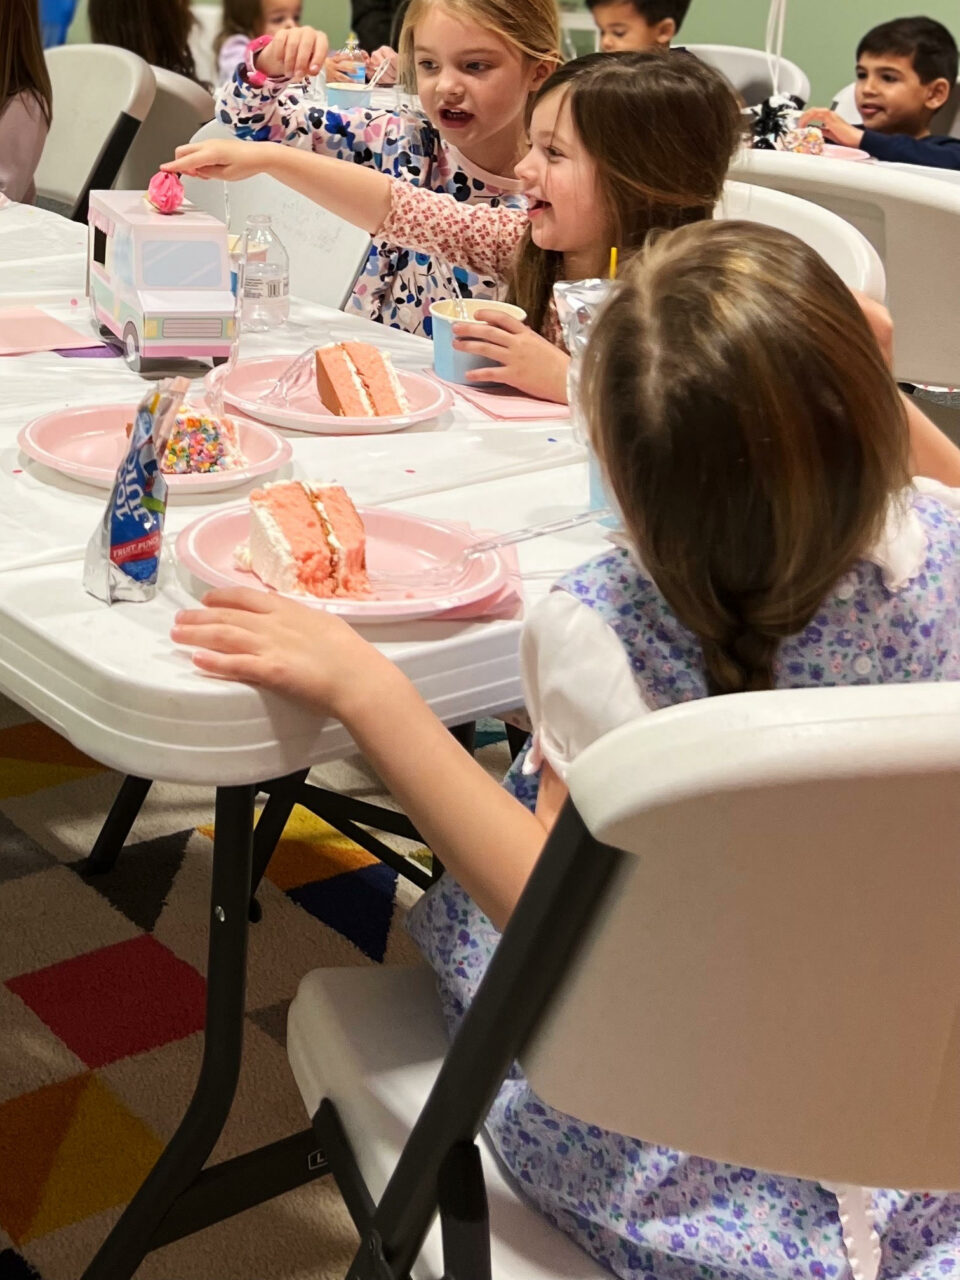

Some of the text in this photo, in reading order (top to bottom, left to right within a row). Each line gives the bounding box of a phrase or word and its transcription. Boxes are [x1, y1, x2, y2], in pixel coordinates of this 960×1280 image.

[126, 452, 154, 525] JUIC
[113, 543, 137, 558] FRUIT
[137, 535, 159, 552] PUNC
